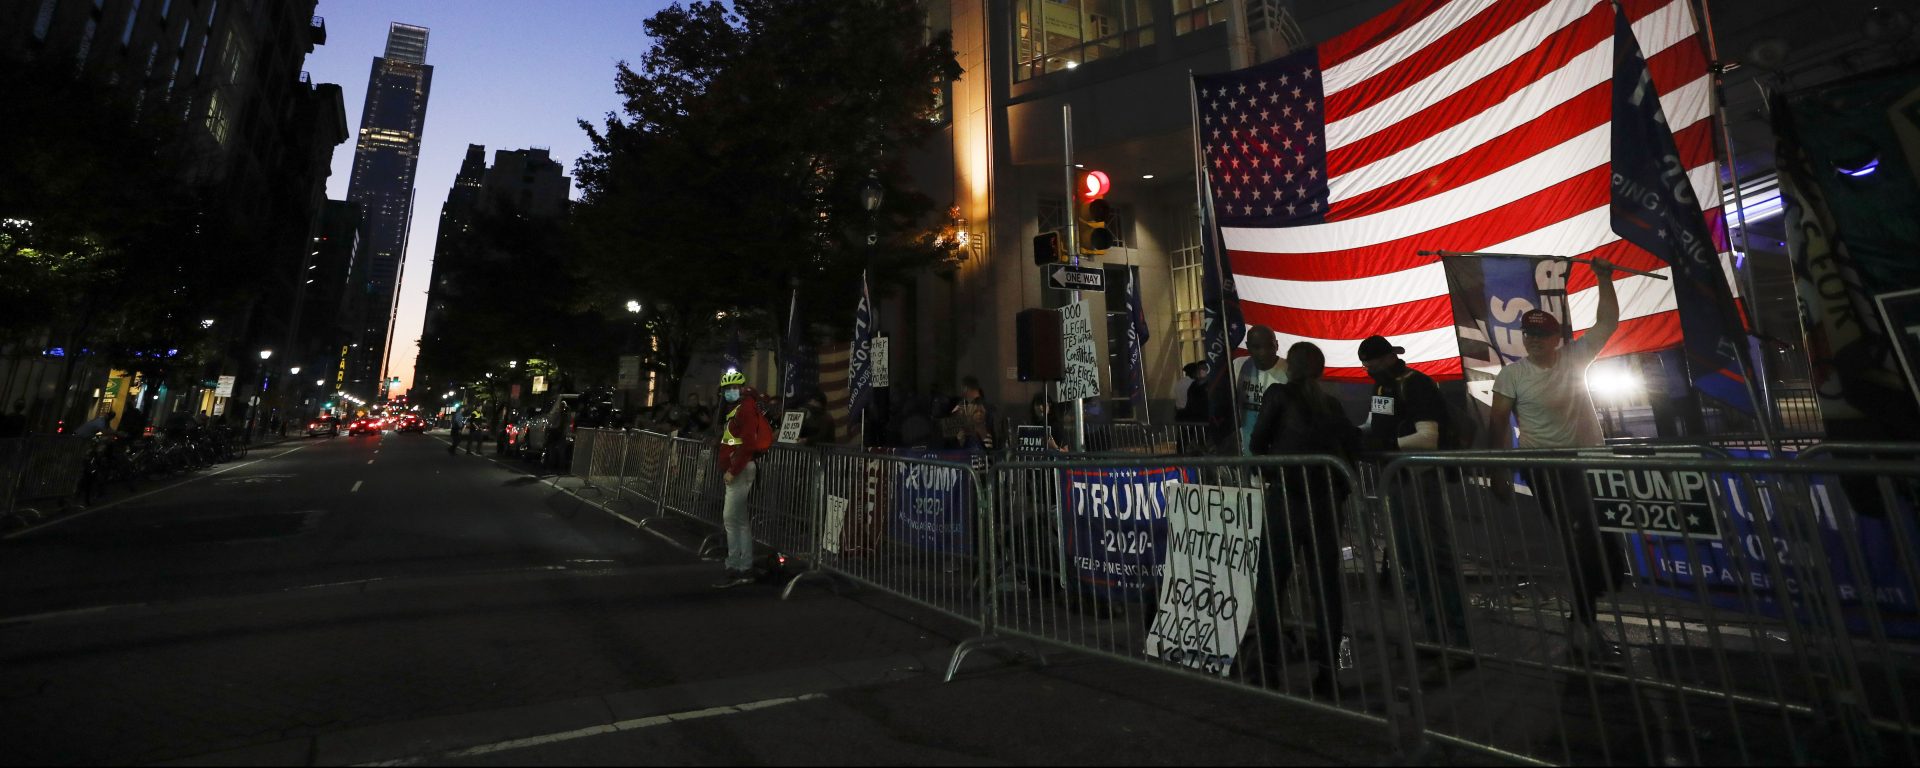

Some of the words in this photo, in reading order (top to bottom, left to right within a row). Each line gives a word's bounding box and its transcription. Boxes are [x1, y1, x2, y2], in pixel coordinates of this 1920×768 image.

[1066, 272, 1080, 283] ONE
[1083, 273, 1099, 284] WAY
[1019, 437, 1044, 447] TRUM
[1587, 469, 1704, 500] TRUMP
[1174, 487, 1200, 515] NO
[1618, 503, 1682, 530] 2020
[1165, 577, 1238, 620] 150,000
[1150, 609, 1216, 653] ILLEGAL
